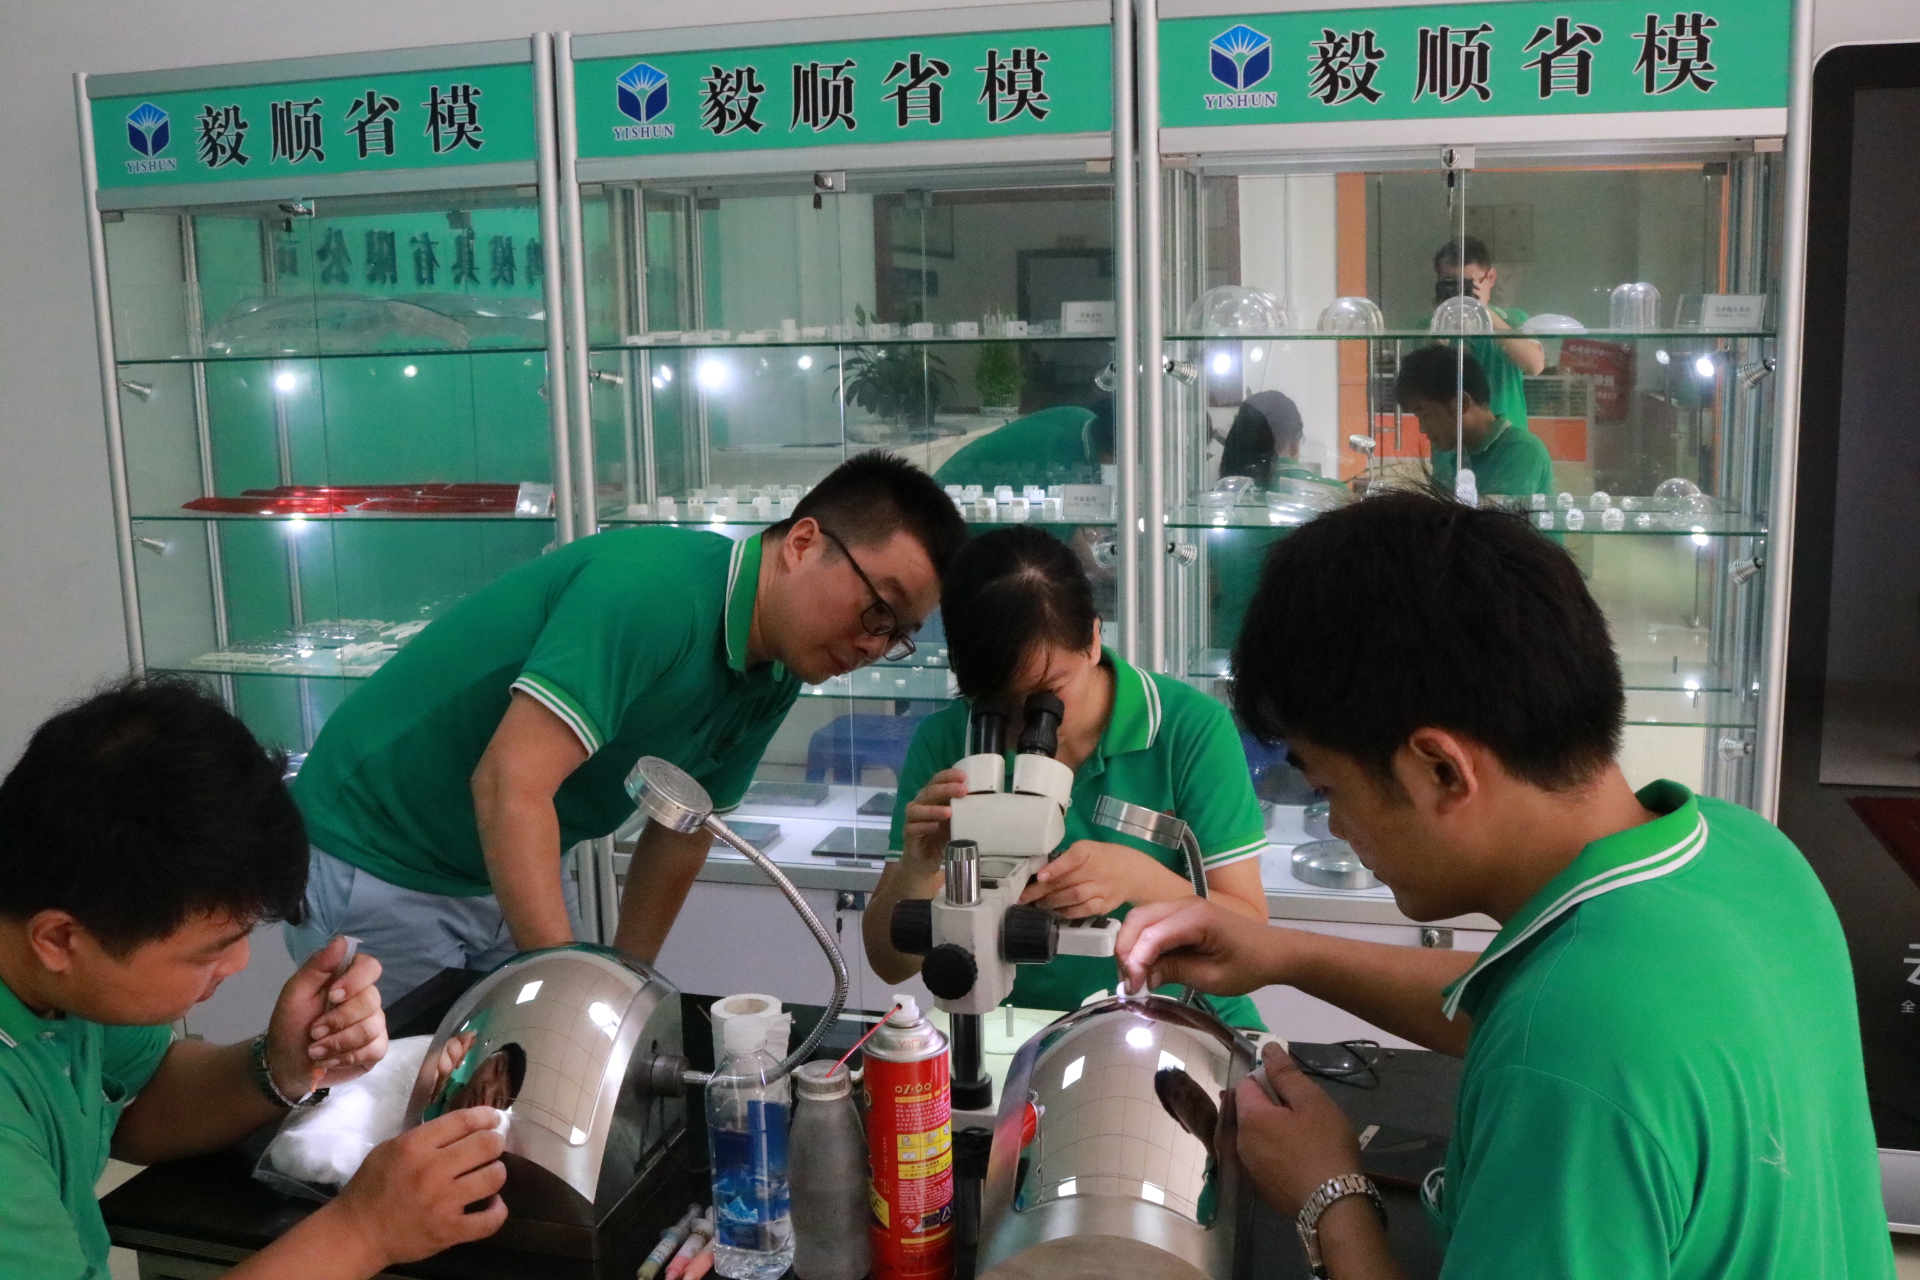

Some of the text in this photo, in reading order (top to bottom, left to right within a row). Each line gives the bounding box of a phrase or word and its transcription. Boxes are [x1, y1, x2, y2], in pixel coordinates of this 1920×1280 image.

[1308, 13, 1719, 105] 毅顺省模
[700, 48, 1051, 136] 毅顺省模
[1205, 92, 1277, 109] YISHUN
[196, 84, 485, 168] 毅顺省模
[613, 124, 674, 140] YISHUN
[126, 159, 176, 174] YISHUN
